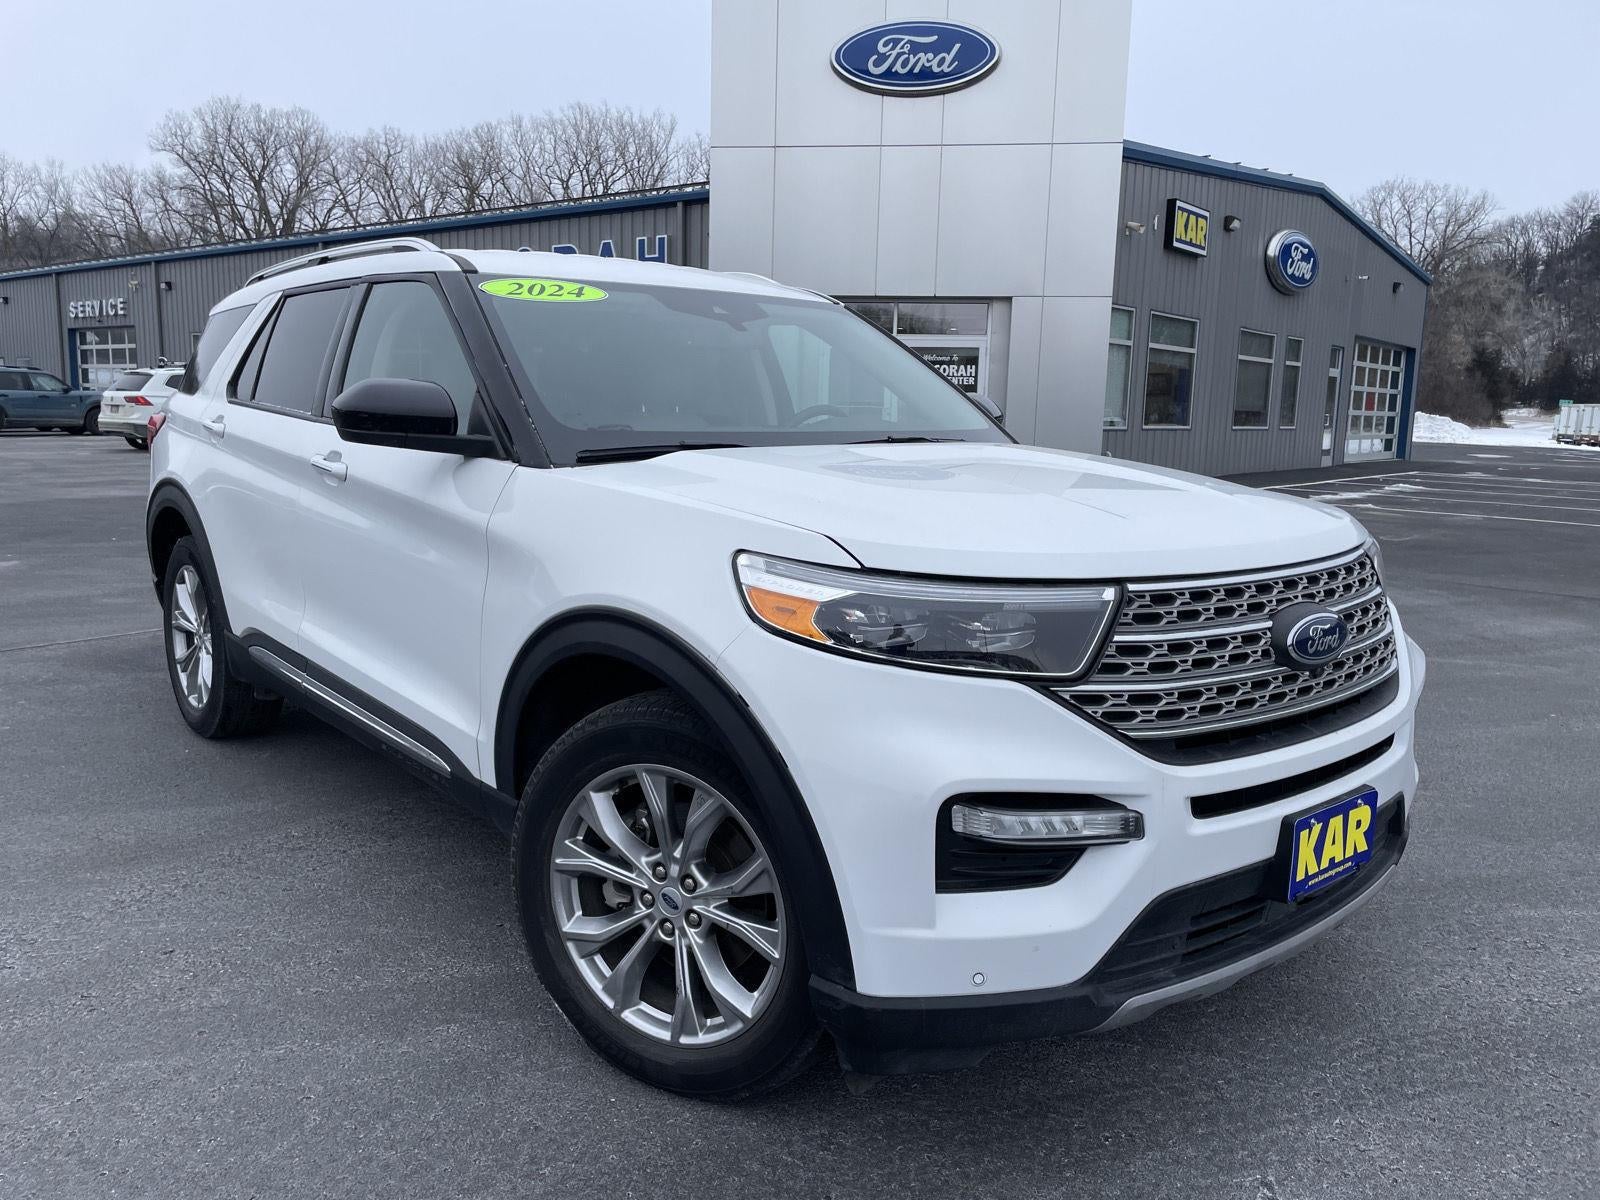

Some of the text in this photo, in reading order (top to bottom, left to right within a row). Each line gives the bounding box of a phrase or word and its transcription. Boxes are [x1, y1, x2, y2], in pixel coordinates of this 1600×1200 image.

[867, 34, 961, 75] Ford
[1175, 209, 1208, 247] KAR
[1286, 243, 1314, 281] Ford
[506, 282, 585, 298] 2024
[69, 298, 125, 318] SERVICE
[923, 353, 959, 362] Welcome To
[933, 364, 976, 377] ORAH
[1307, 623, 1339, 654] Ford
[1295, 804, 1372, 882] KAR
